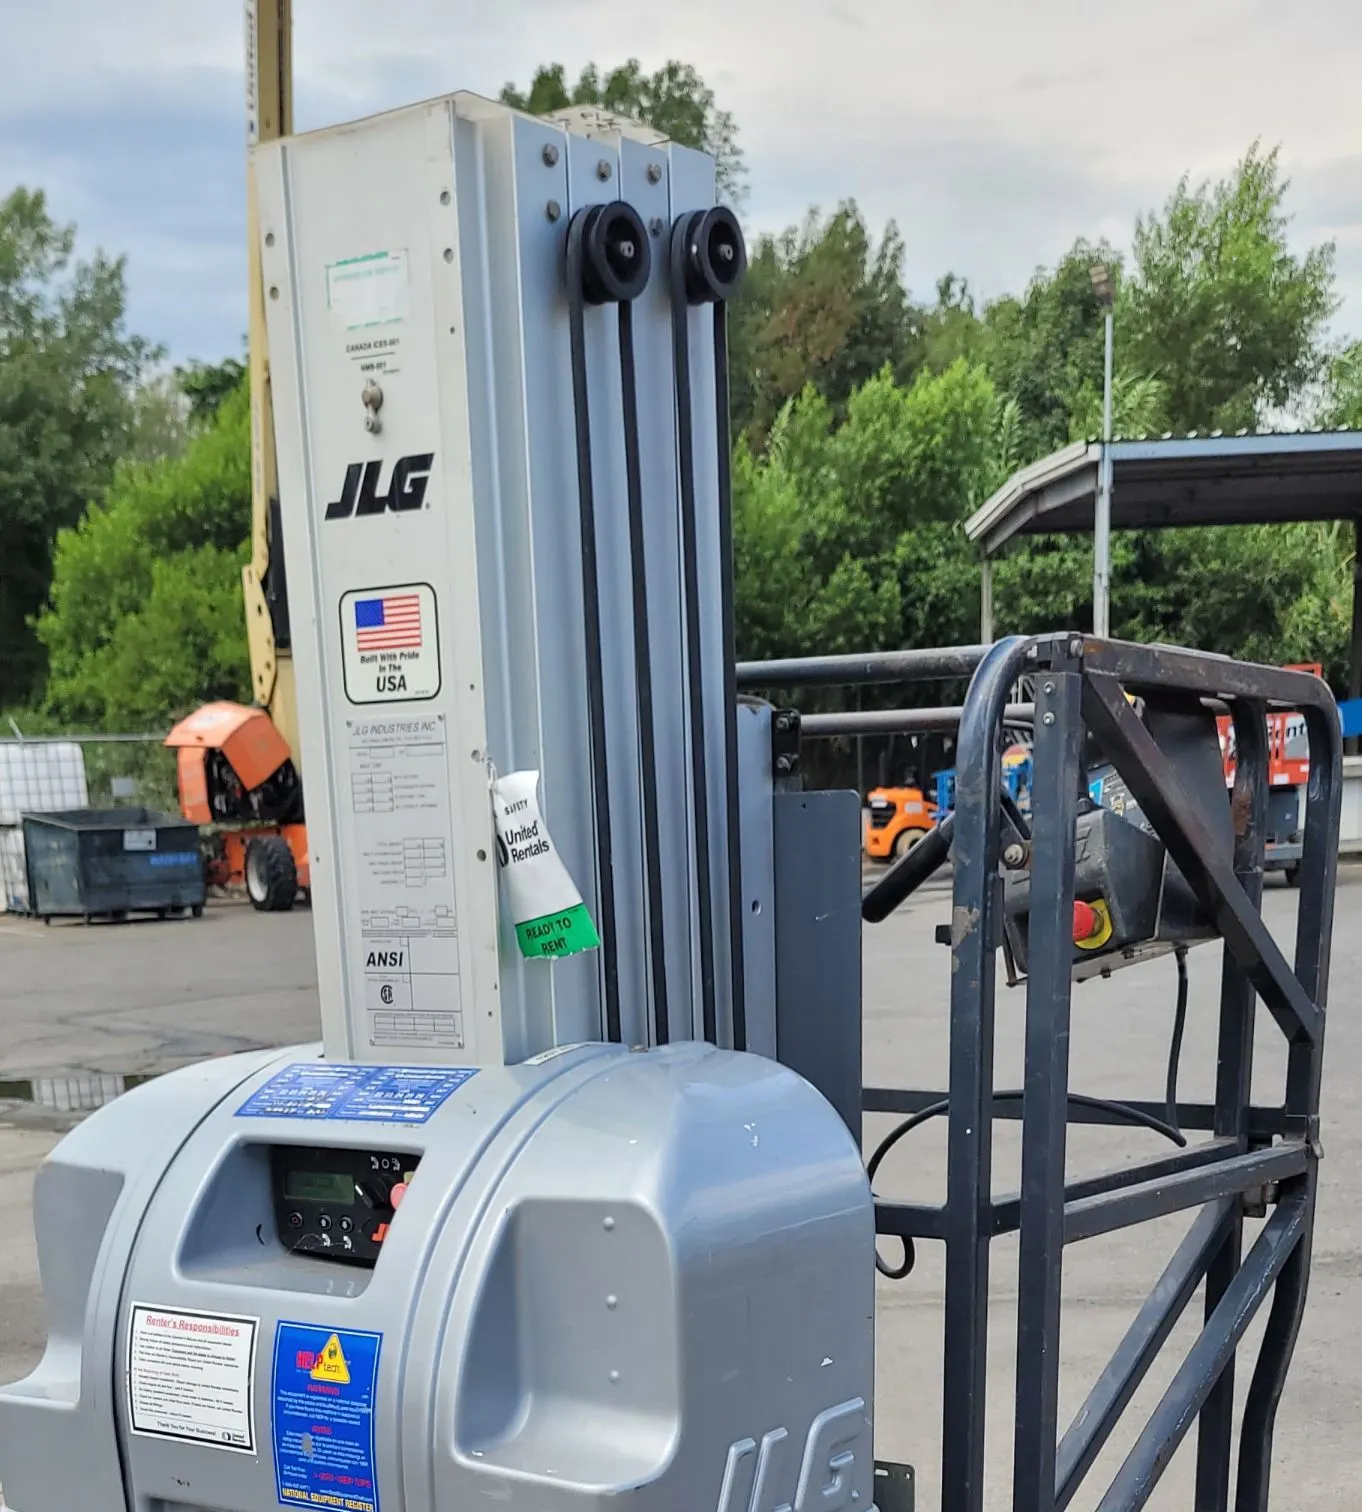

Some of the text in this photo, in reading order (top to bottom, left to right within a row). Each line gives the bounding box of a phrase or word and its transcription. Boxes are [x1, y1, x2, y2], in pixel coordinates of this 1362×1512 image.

[345, 341, 372, 353] CANADA
[324, 452, 435, 521] JLG
[400, 650, 420, 661] Pride
[376, 674, 408, 693] USA
[370, 722, 419, 735] INDUSTRIES
[504, 820, 539, 846] United
[510, 838, 550, 864] Rentals
[526, 917, 572, 941] READY TO
[541, 937, 568, 954] RENT
[366, 952, 404, 968] ANSI
[146, 1315, 241, 1337] Renter's Responsibilities
[310, 1492, 344, 1507] EQUIPMENT
[345, 1498, 374, 1512] REGISTER
